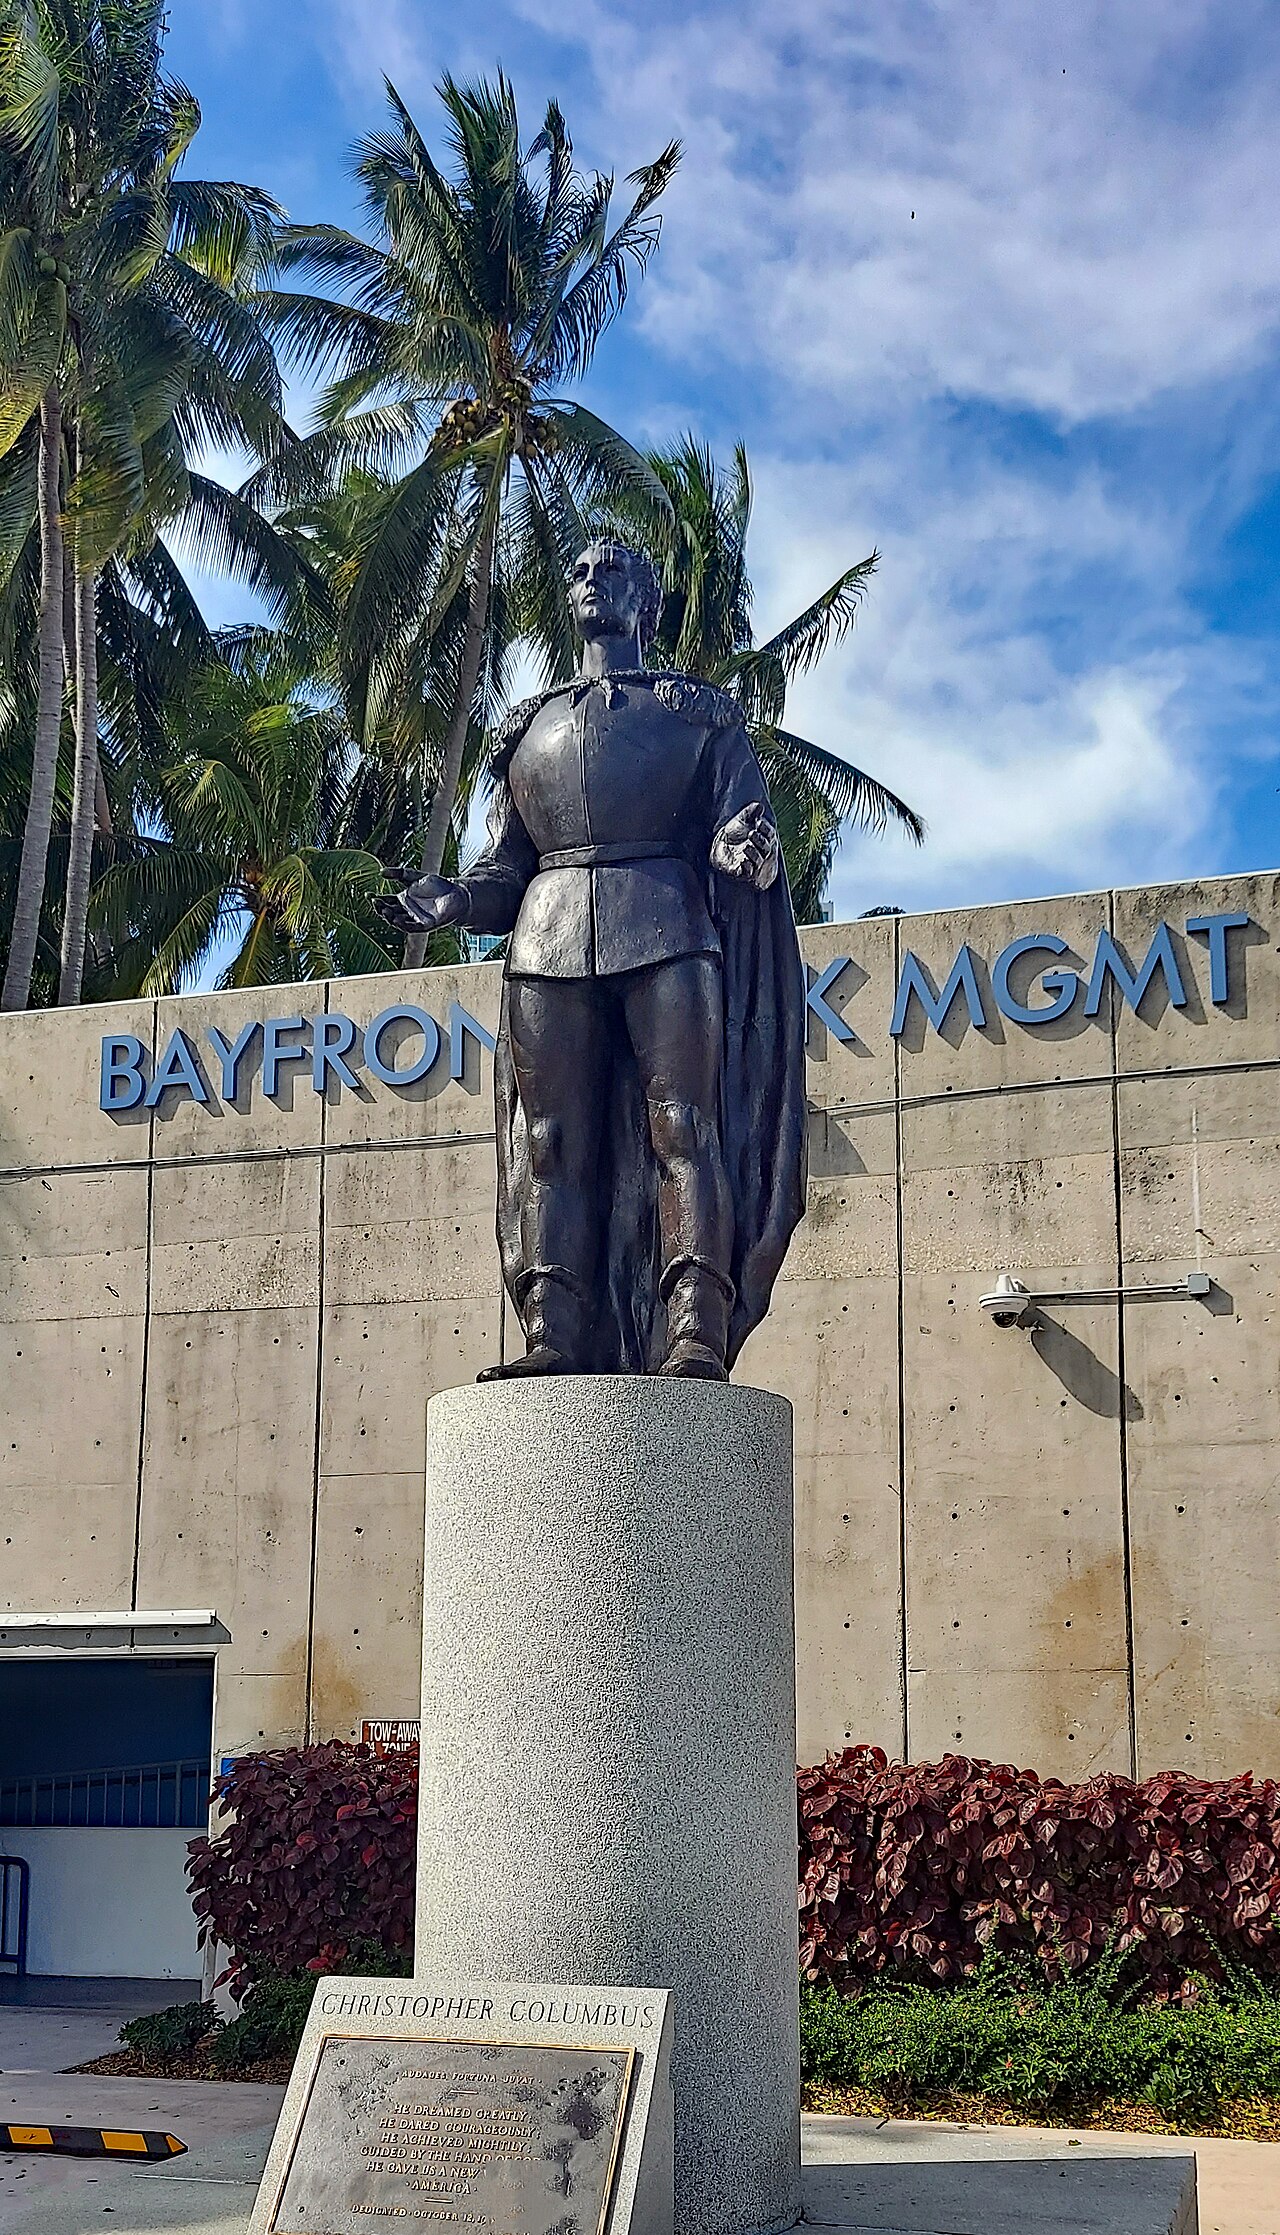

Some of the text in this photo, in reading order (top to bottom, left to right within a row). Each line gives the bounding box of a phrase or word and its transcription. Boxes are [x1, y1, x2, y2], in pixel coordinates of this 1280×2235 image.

[100, 1001, 497, 1111] BAYFRON
[889, 911, 1249, 1037] MGMT
[320, 1993, 655, 2028] CHRISTOPHER COLUMBUS
[394, 2104, 411, 2115] HE
[414, 2105, 471, 2119] DREAMED
[379, 2117, 396, 2128] HE
[399, 2119, 440, 2131] DARED
[380, 2132, 398, 2143] HE
[401, 2133, 464, 2148] ACHIEVED
[360, 2146, 407, 2158] GUIDED
[410, 2149, 426, 2160] BY
[428, 2150, 451, 2162] THE
[454, 2151, 492, 2164] HAND
[366, 2161, 480, 2179] HE GAVE US A NEW
[411, 2179, 471, 2195] AMERICA
[352, 2204, 407, 2217] DEDICATED
[413, 2209, 459, 2221] OCTOBER
